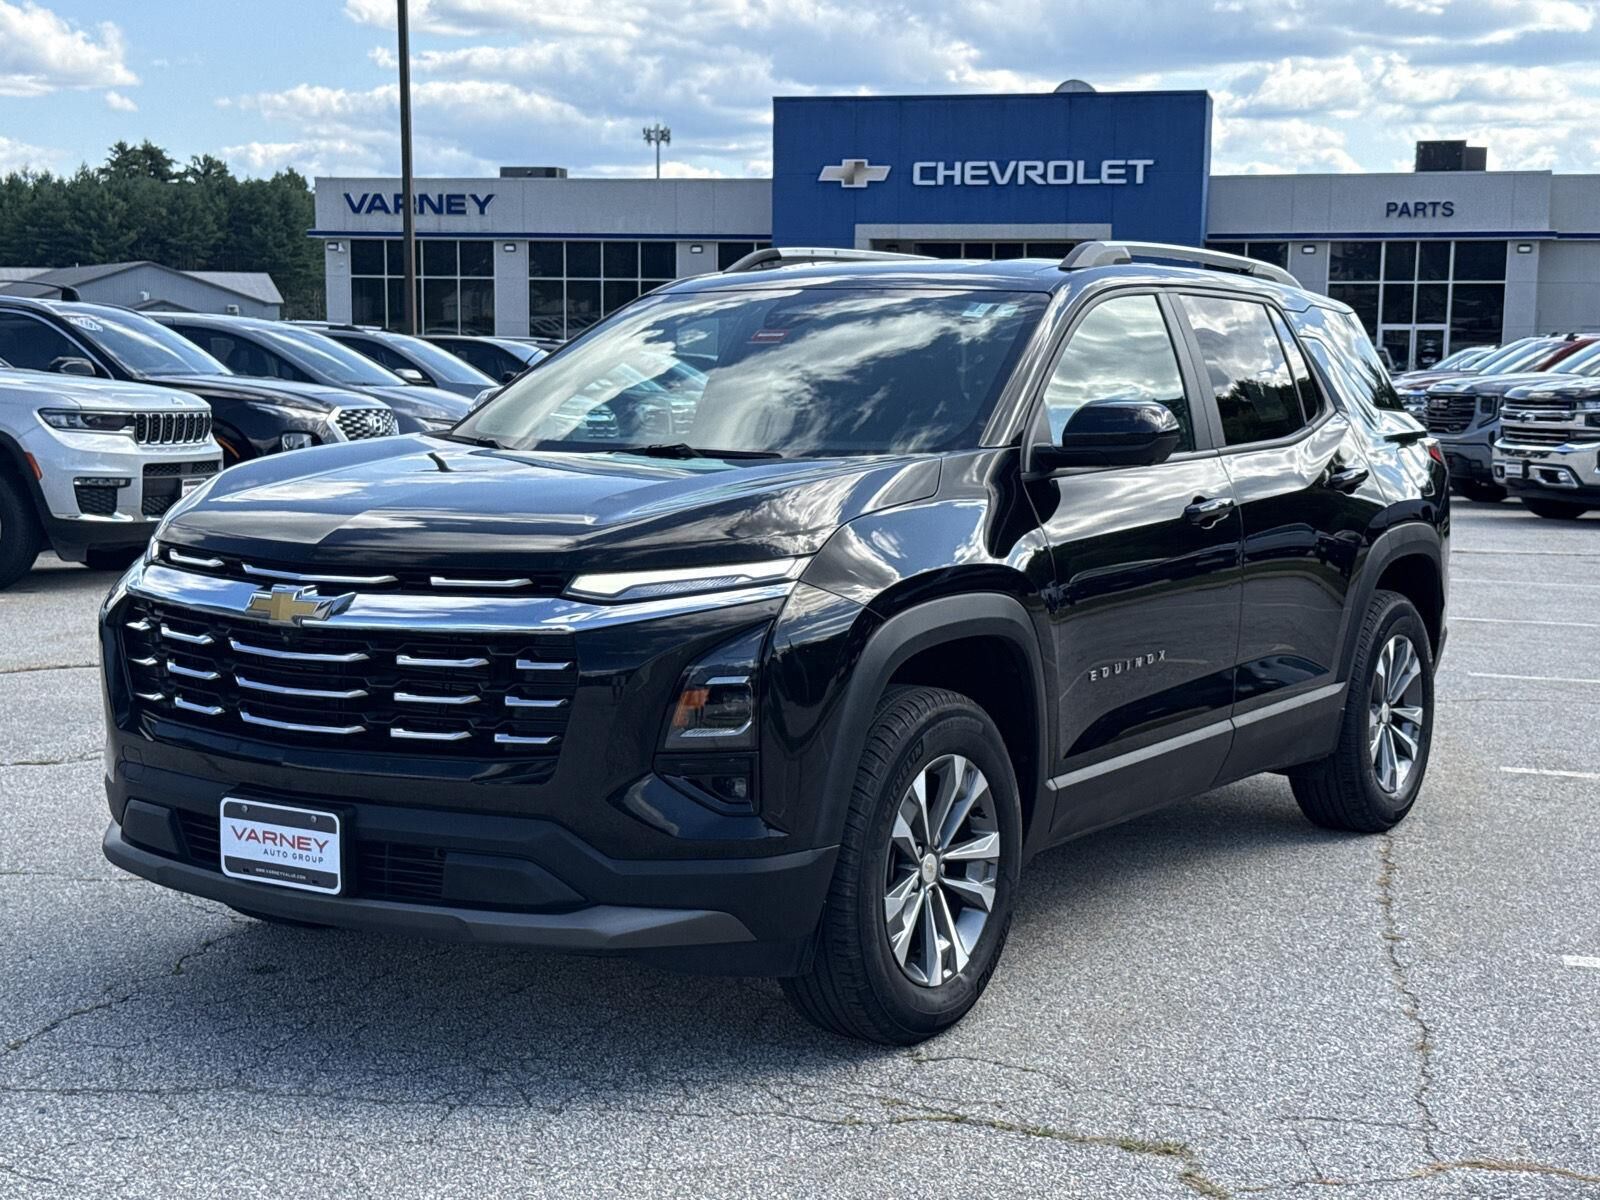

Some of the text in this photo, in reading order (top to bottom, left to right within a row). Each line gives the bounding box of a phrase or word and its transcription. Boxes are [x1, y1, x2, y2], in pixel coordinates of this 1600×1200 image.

[912, 159, 1154, 186] CHEVROLET
[1385, 201, 1455, 218] PARTS
[1089, 649, 1166, 682] EQUINOX
[231, 825, 329, 854] VARNEY
[263, 848, 324, 864] AUTO GROUP
